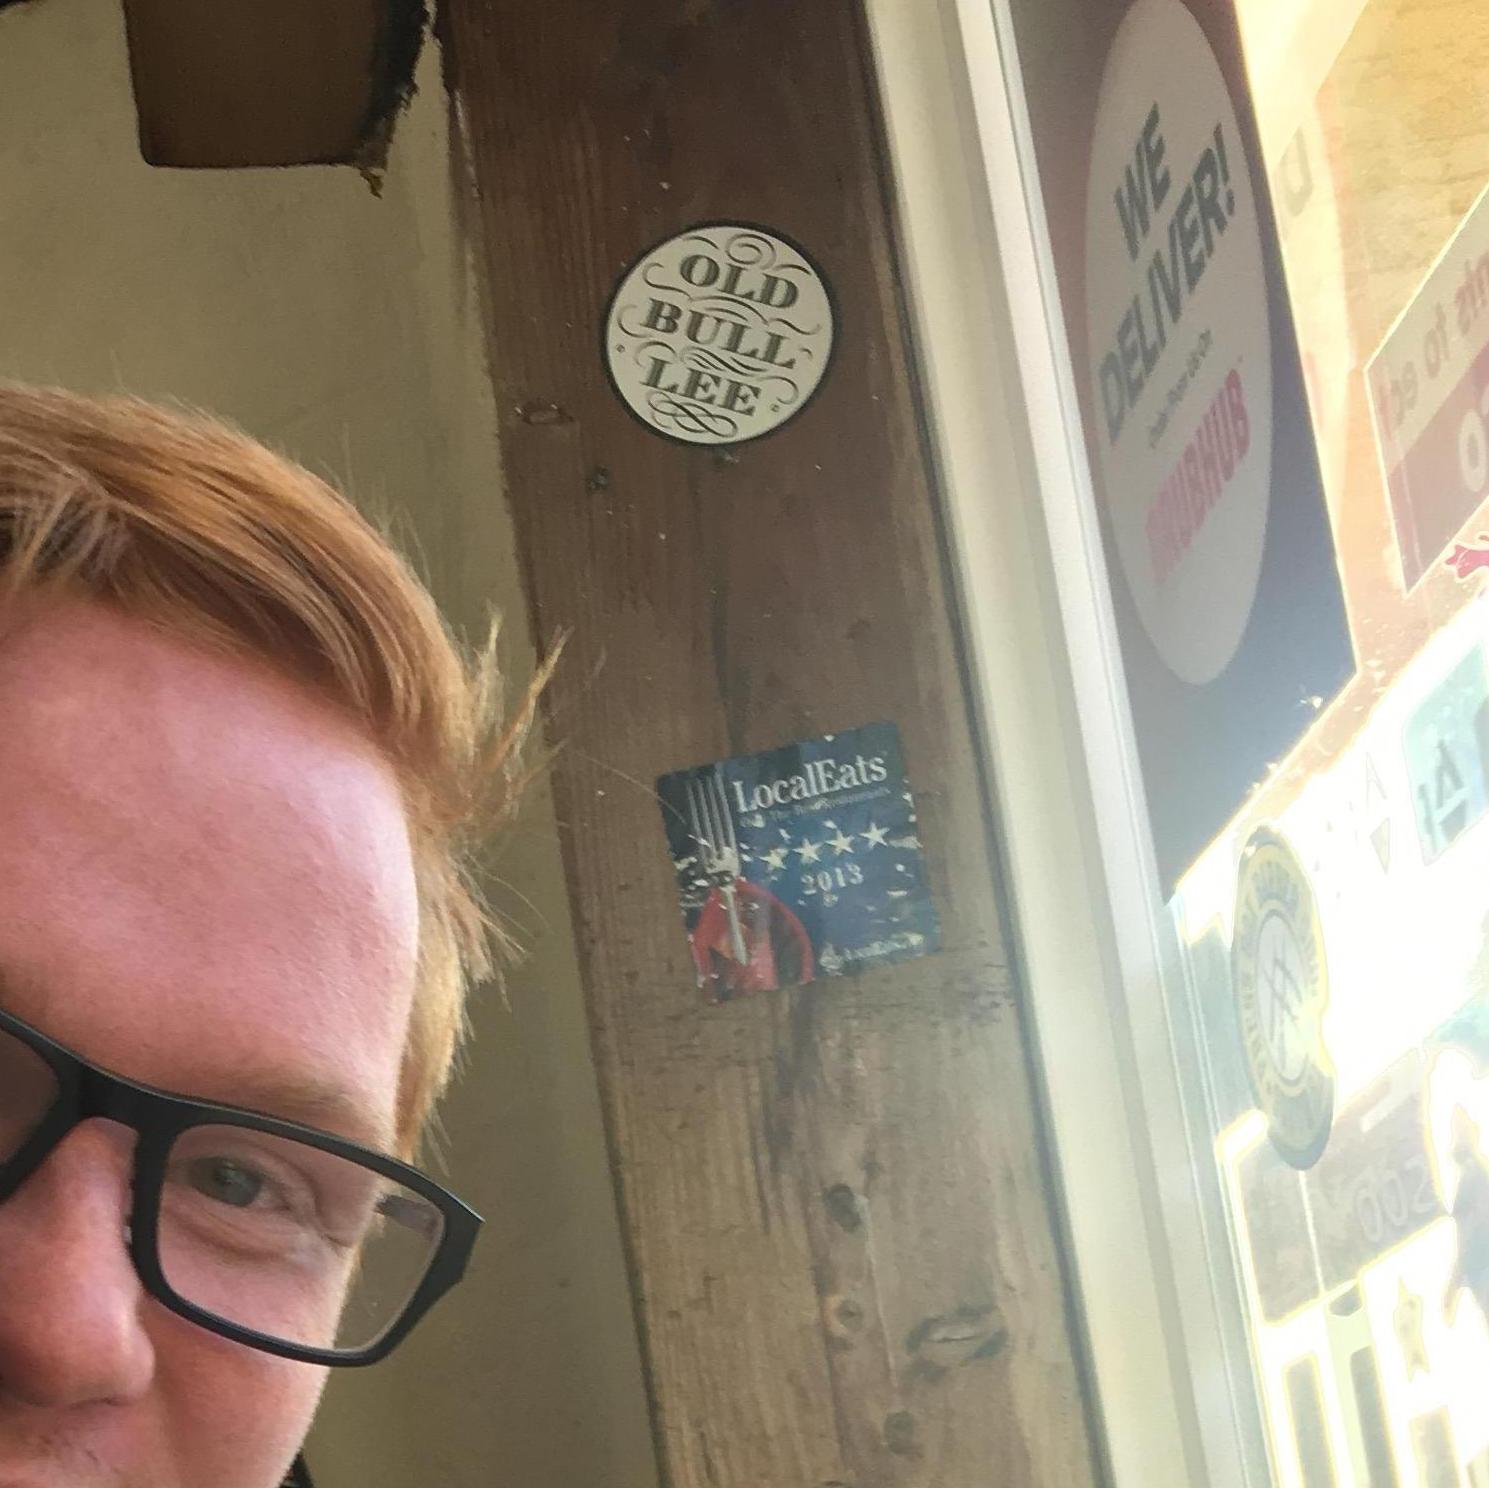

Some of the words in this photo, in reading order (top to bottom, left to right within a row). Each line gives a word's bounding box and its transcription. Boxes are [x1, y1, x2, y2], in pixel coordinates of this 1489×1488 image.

[1114, 101, 1171, 262] WE
[679, 253, 799, 309] OLD
[1099, 122, 1235, 444] DELIVER!
[639, 298, 797, 370] BULL
[639, 356, 763, 416] LEE
[731, 753, 888, 814] LocalEats
